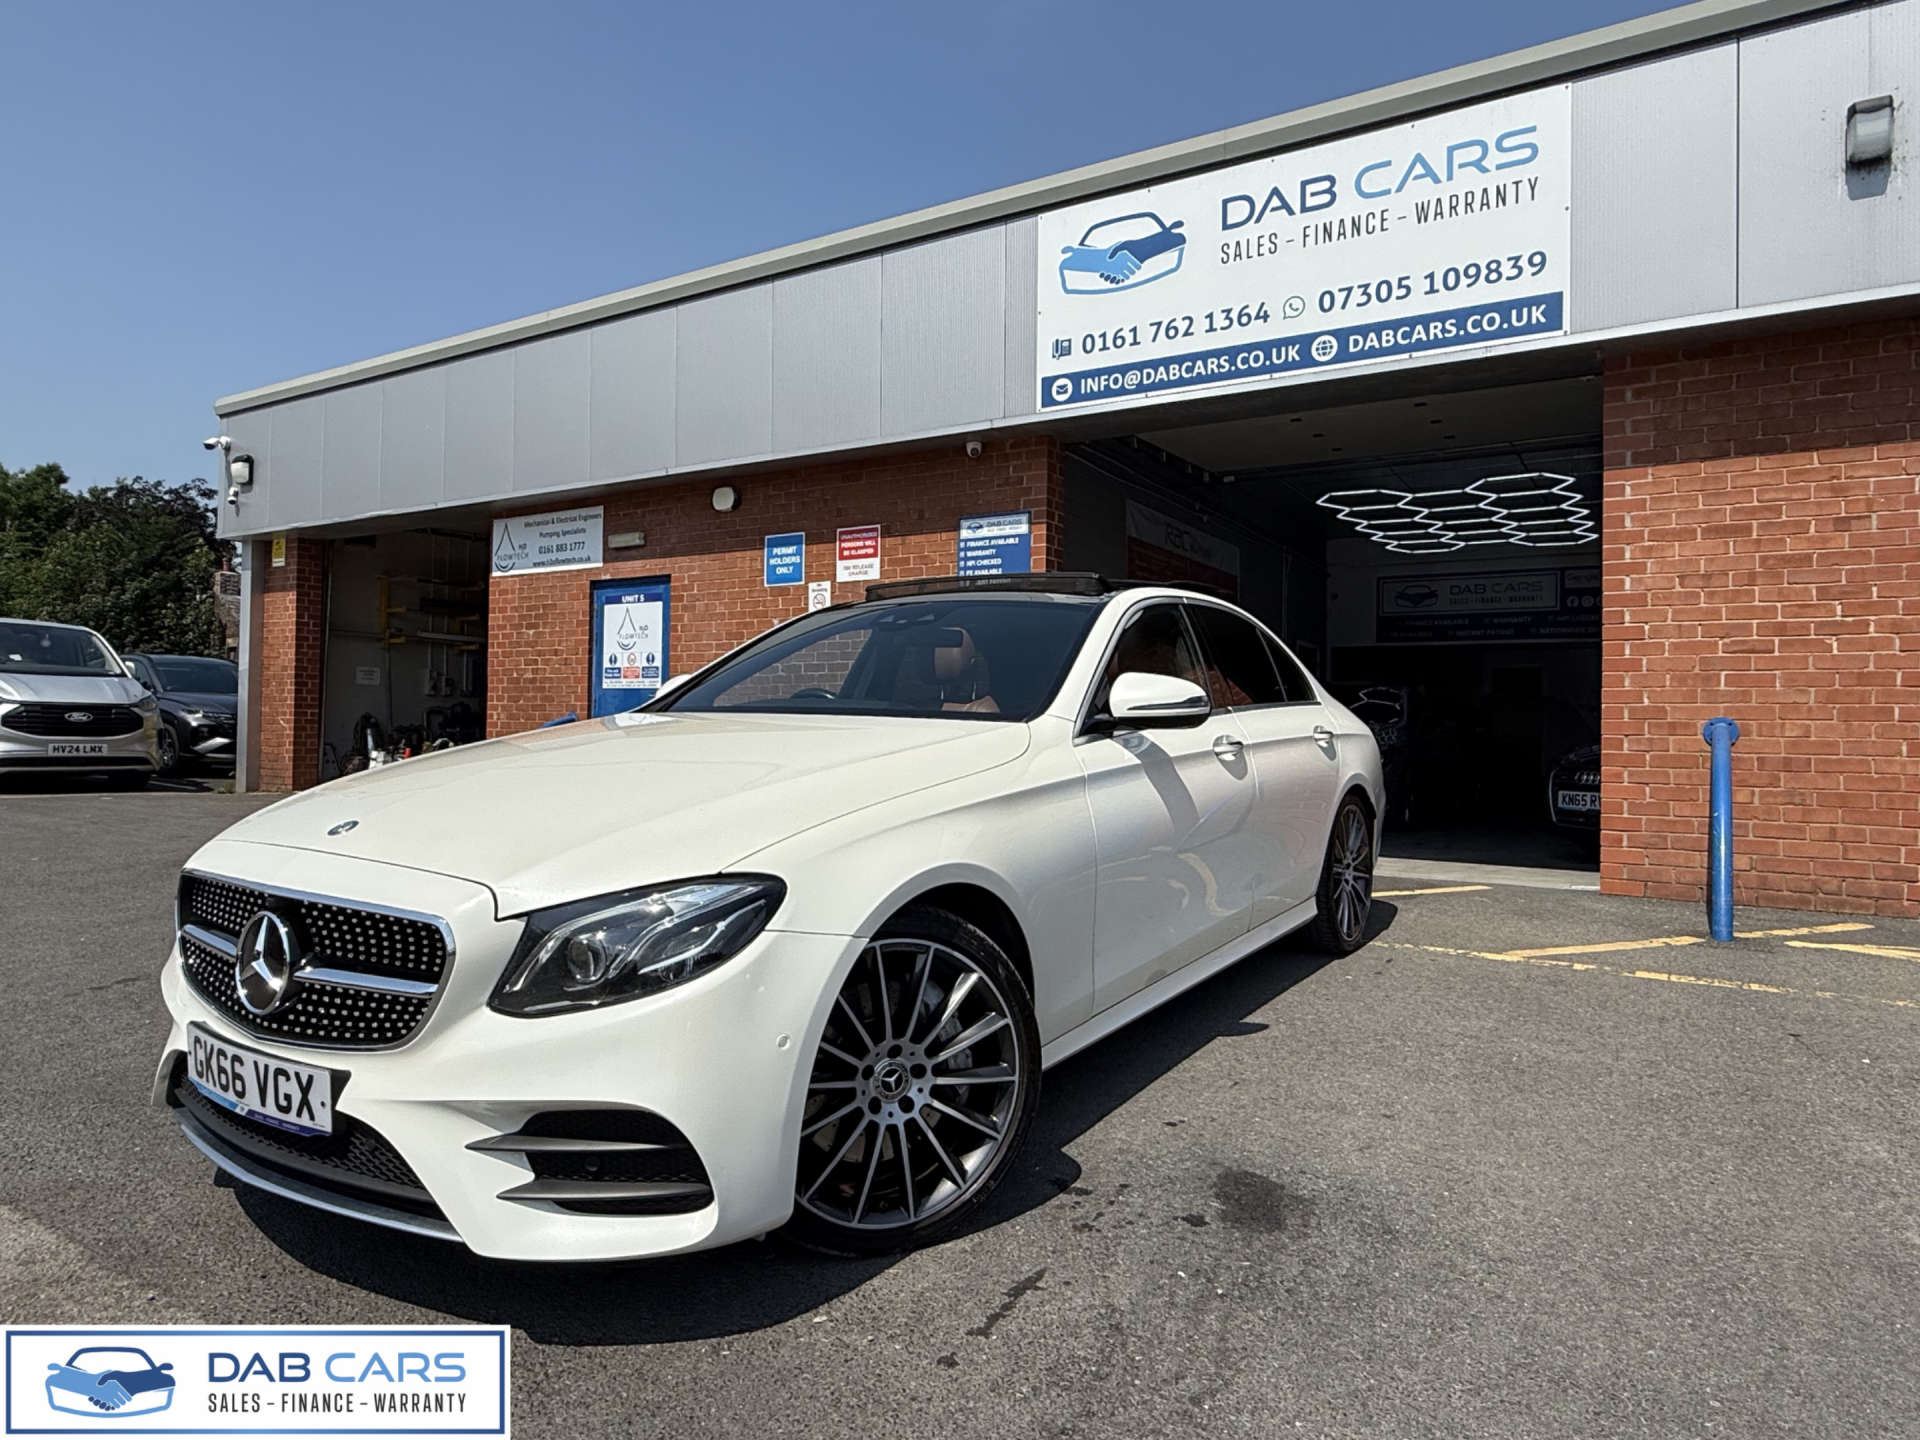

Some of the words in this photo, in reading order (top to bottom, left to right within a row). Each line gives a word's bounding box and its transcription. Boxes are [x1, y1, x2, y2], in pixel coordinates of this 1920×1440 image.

[1221, 174, 1337, 231] DAB
[1353, 125, 1540, 199] CARS
[1220, 232, 1278, 265] SALES
[1302, 208, 1390, 248] FINANCE
[1415, 176, 1539, 225] WARRANTY
[1318, 275, 1412, 313] 07305
[1423, 250, 1548, 296] 109839
[1081, 325, 1142, 355] 0161
[1149, 315, 1195, 343] 762
[1203, 302, 1271, 334] 1364
[1348, 303, 1547, 353] DABCARS.CO.UK
[1080, 343, 1301, 395] INFO@DABCARS.CO.UK
[569, 541, 585, 552] 1777
[966, 539, 989, 547] FINANCE
[990, 537, 1019, 545] AVAILABLE
[773, 546, 797, 555] PERMIT
[769, 555, 800, 565] HOLDERS
[976, 558, 1002, 566] CHECKED
[776, 566, 794, 575] ONLY
[1449, 583, 1487, 596] DAB
[1490, 581, 1543, 594] CARS
[621, 594, 638, 603] UNIT
[53, 744, 80, 754] HV24
[1561, 793, 1587, 807] KN65
[193, 1035, 247, 1100] GK66
[253, 1060, 316, 1122] VGX
